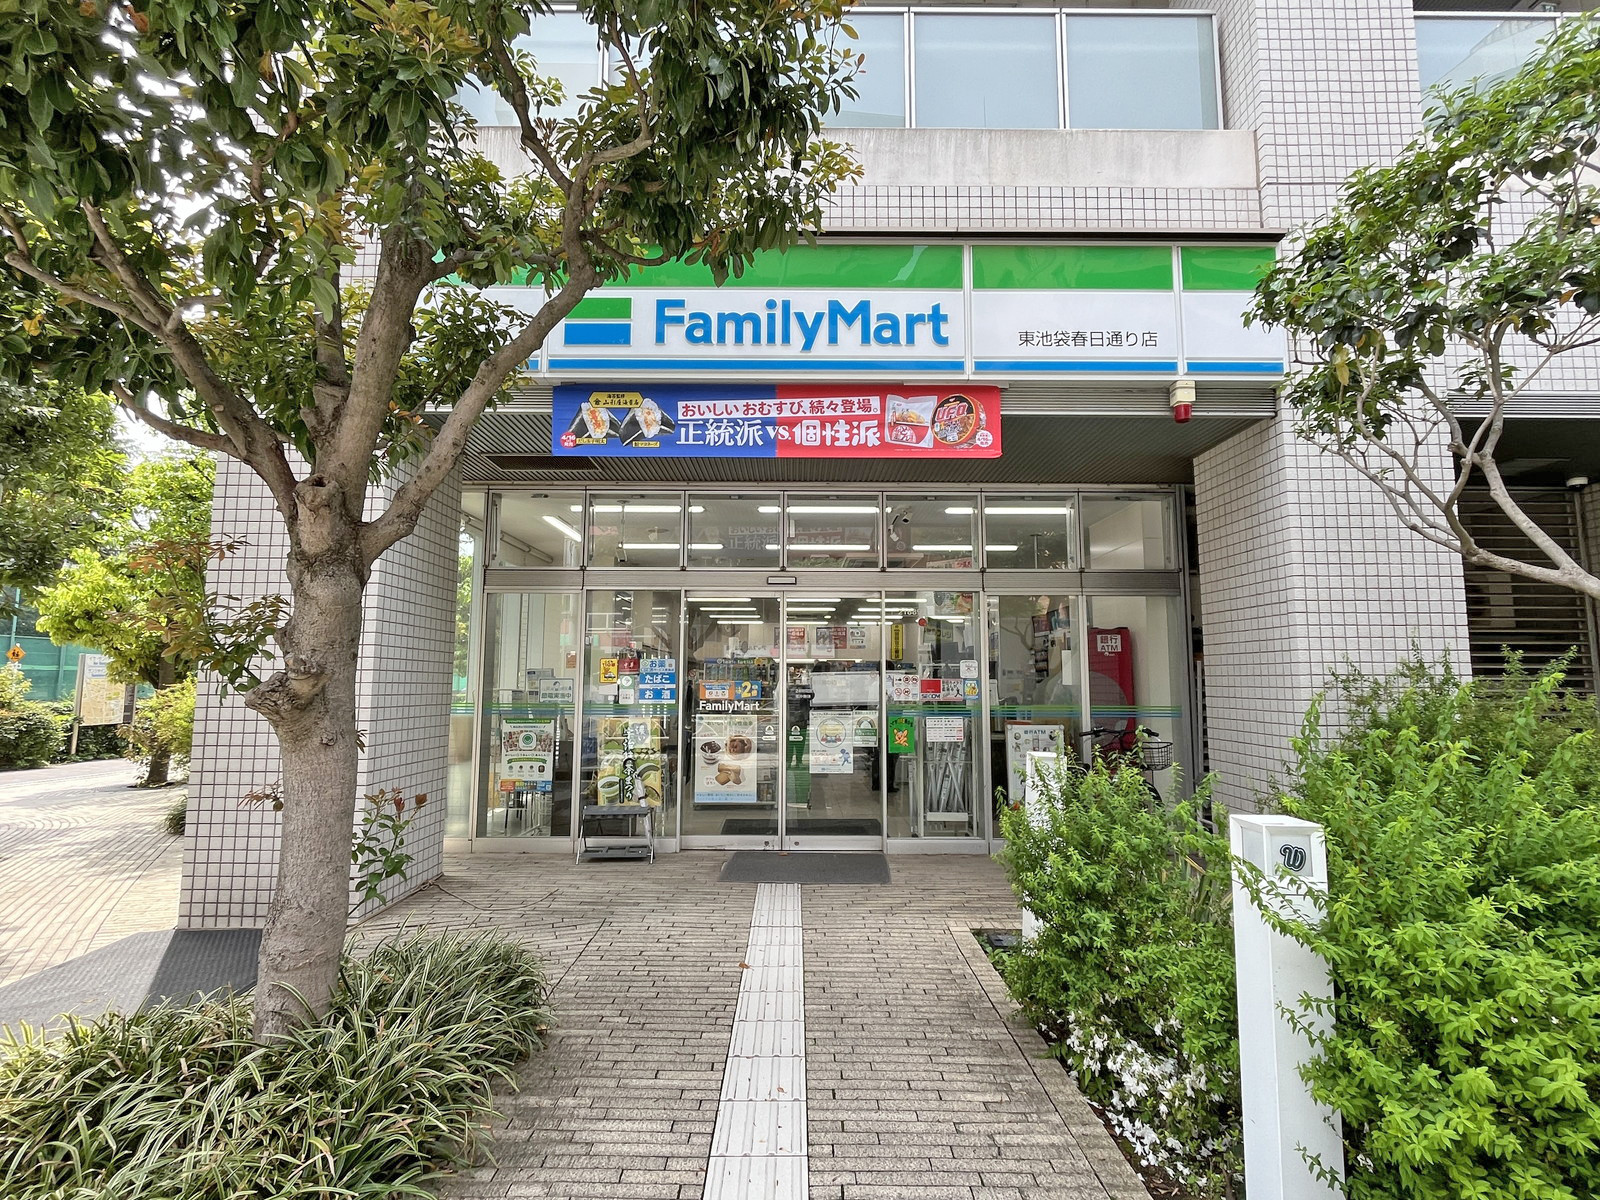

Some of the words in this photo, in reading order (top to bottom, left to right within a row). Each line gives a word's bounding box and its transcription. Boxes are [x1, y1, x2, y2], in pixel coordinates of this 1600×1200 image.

[655, 298, 949, 353] FamilyMart
[1018, 330, 1158, 348] 東池袋春日通り店
[676, 418, 764, 447] 正統派
[792, 418, 882, 448] 個性派
[1100, 635, 1118, 644] 銀行
[645, 674, 670, 683] たばこ
[644, 690, 671, 699] お酒
[700, 700, 760, 713] FamilyMart
